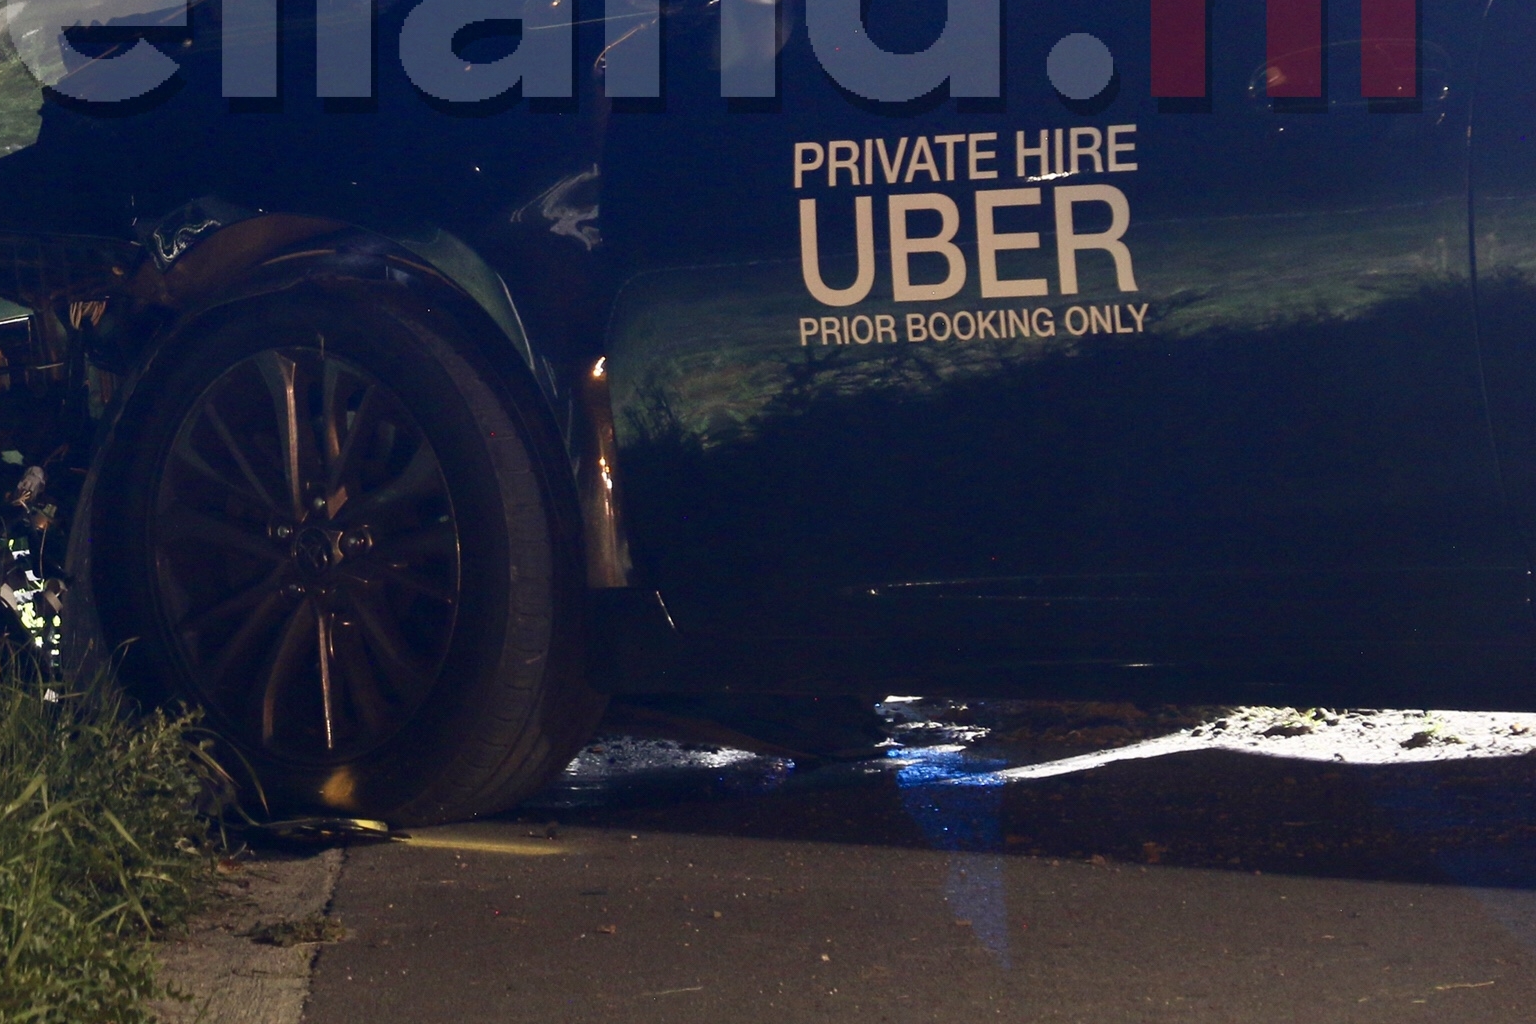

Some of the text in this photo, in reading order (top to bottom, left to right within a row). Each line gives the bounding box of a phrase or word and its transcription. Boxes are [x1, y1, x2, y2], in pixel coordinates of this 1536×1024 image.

[794, 124, 1139, 189] PRIVATE HIRE
[799, 184, 1139, 307] UBER
[799, 303, 1149, 346] PRIOR BOOKING ONLY
